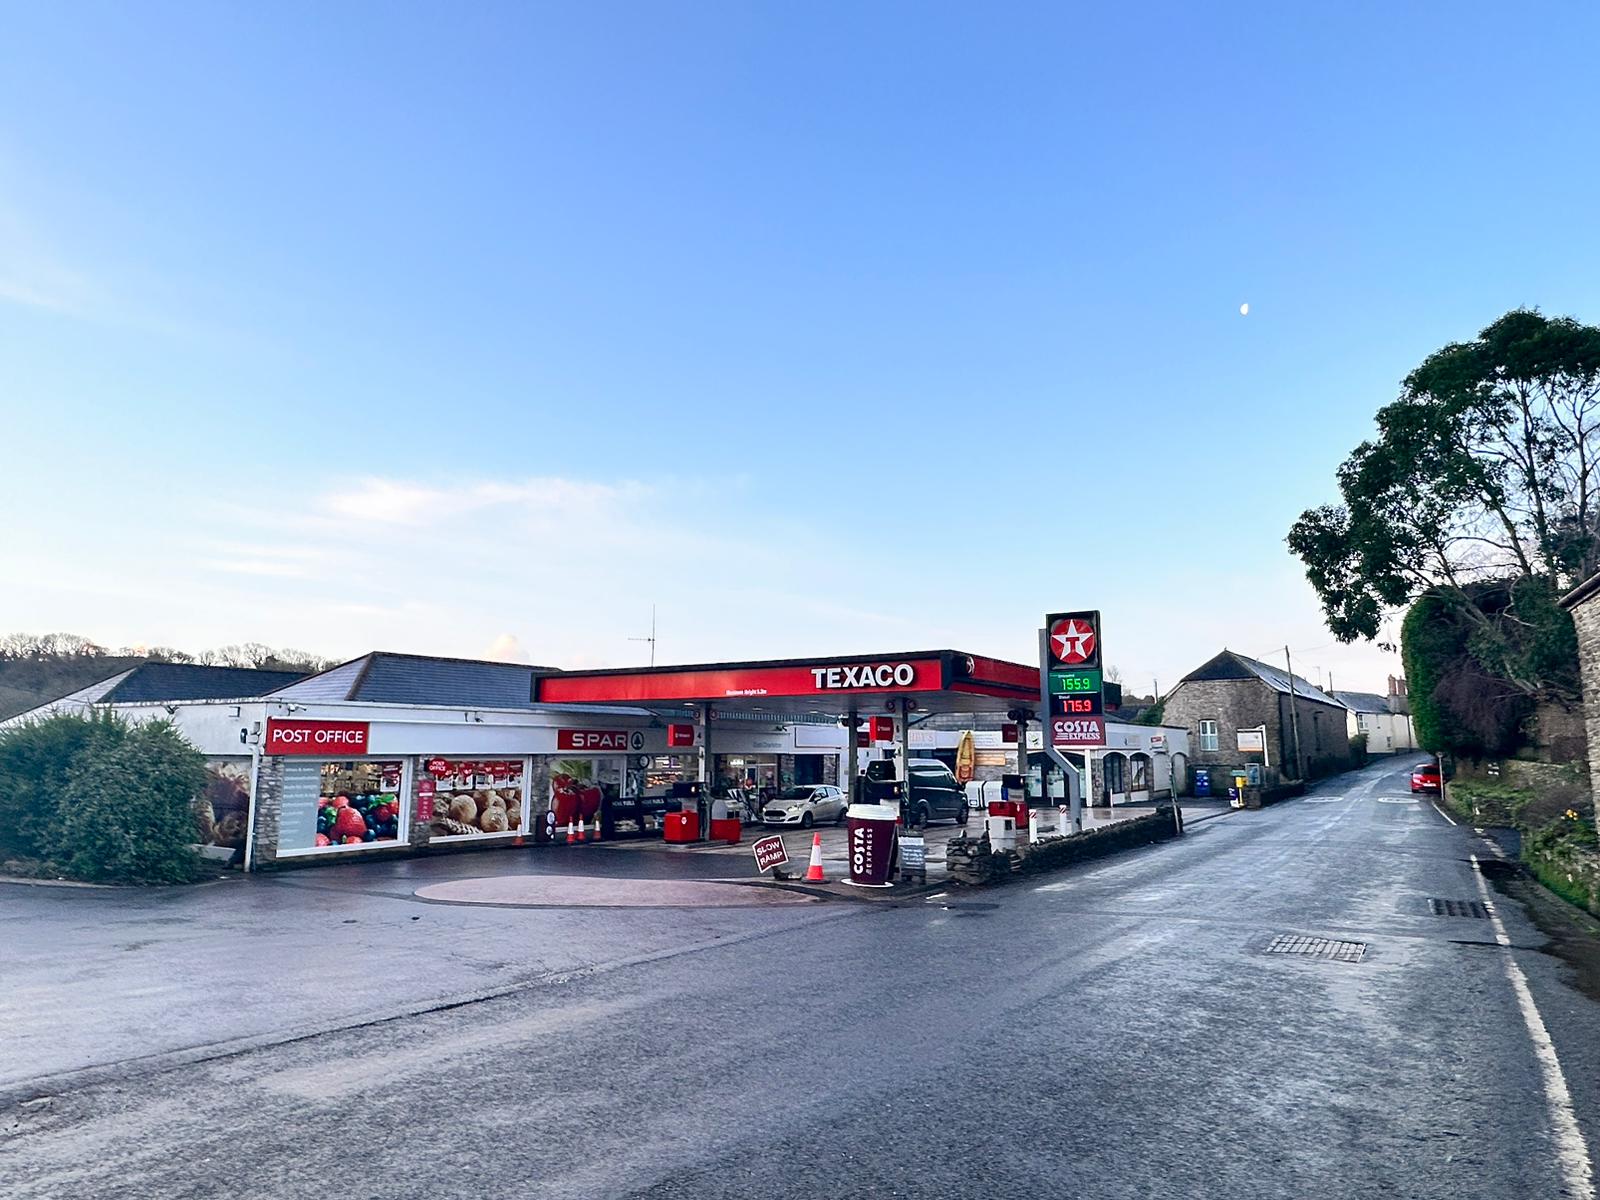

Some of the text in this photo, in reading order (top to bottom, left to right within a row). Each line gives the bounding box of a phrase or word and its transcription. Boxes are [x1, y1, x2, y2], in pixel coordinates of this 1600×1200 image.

[811, 664, 914, 689] TEXACO
[1062, 678, 1090, 690] 155.9
[1063, 700, 1092, 713] 175.9
[1054, 720, 1099, 732] COSTA
[272, 729, 363, 743] POST OFFICE
[571, 733, 627, 748] SPAR
[1068, 732, 1101, 740] EXPRESS
[756, 841, 780, 856] SLOW
[853, 827, 865, 875] COSTA
[760, 851, 783, 866] RAMP
